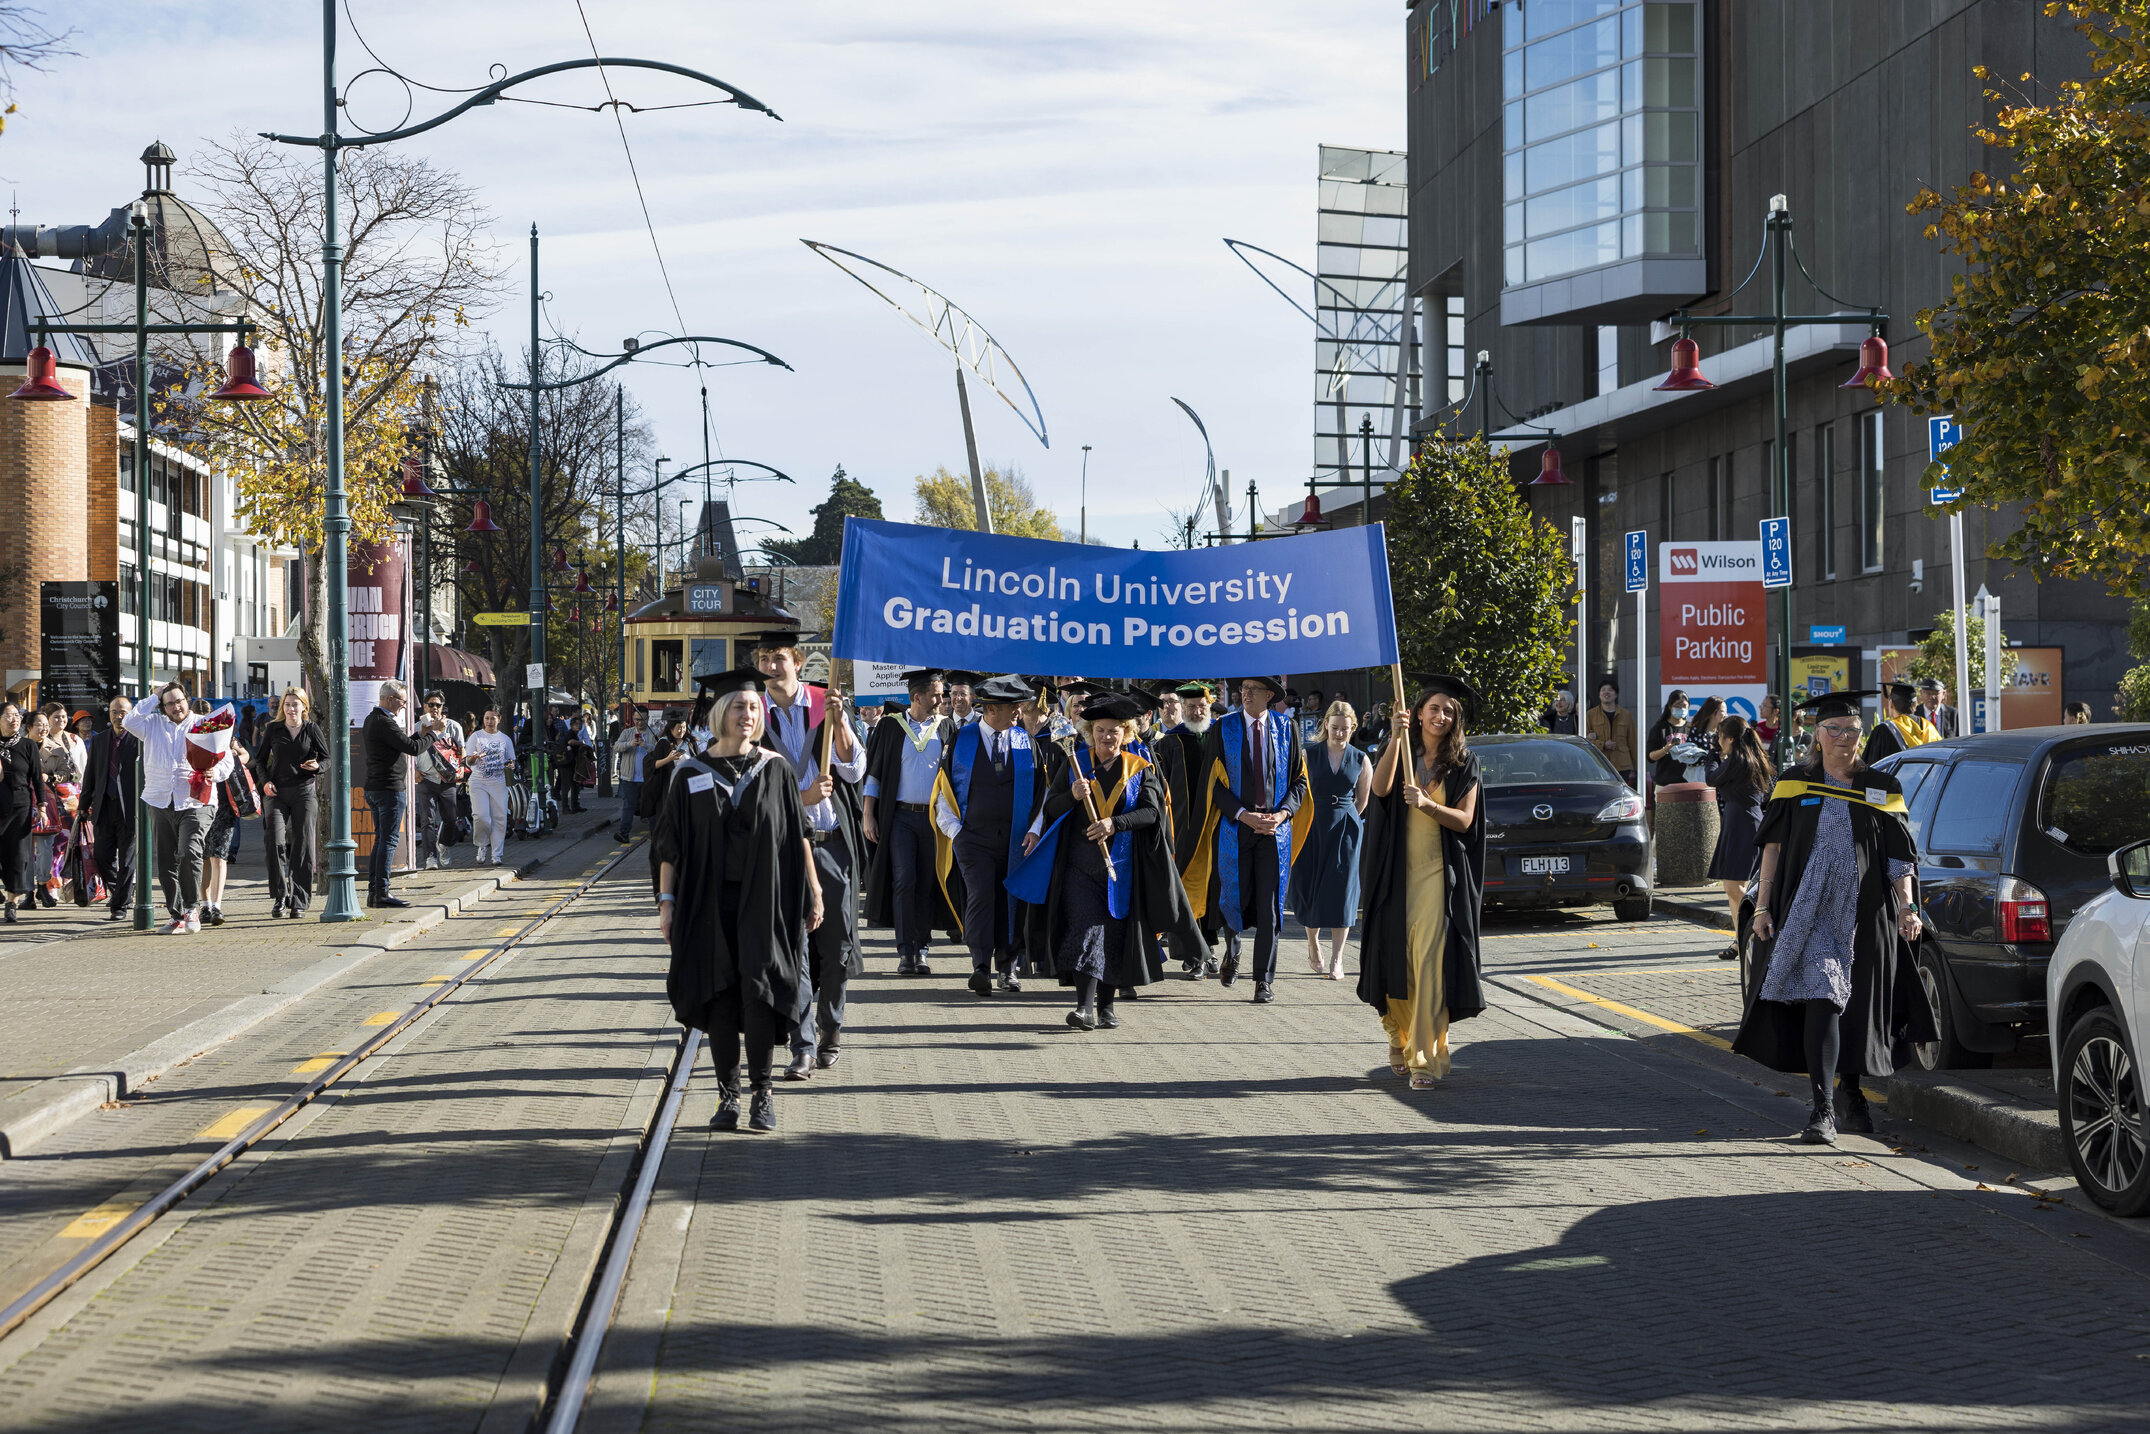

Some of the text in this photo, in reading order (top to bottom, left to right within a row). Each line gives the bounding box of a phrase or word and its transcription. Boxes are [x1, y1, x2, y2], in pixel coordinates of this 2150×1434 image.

[1940, 421, 1950, 440] P
[1769, 522, 1779, 537] P
[1632, 534, 1639, 548] P
[1769, 538, 1782, 551] 120
[1631, 549, 1642, 560] 120
[1701, 554, 1756, 569] Wilson
[941, 556, 1293, 605] Lincoln University
[693, 589, 719, 599] CITY
[690, 600, 722, 610] TOUR
[883, 596, 1350, 647] Graduation Procession
[1681, 603, 1745, 626] Public
[1675, 637, 1752, 664] Parking
[875, 672, 904, 680] Applied
[869, 681, 908, 689] Computing
[1975, 701, 1986, 717] P
[1305, 720, 1314, 730] P
[1523, 858, 1569, 871] FLH113
